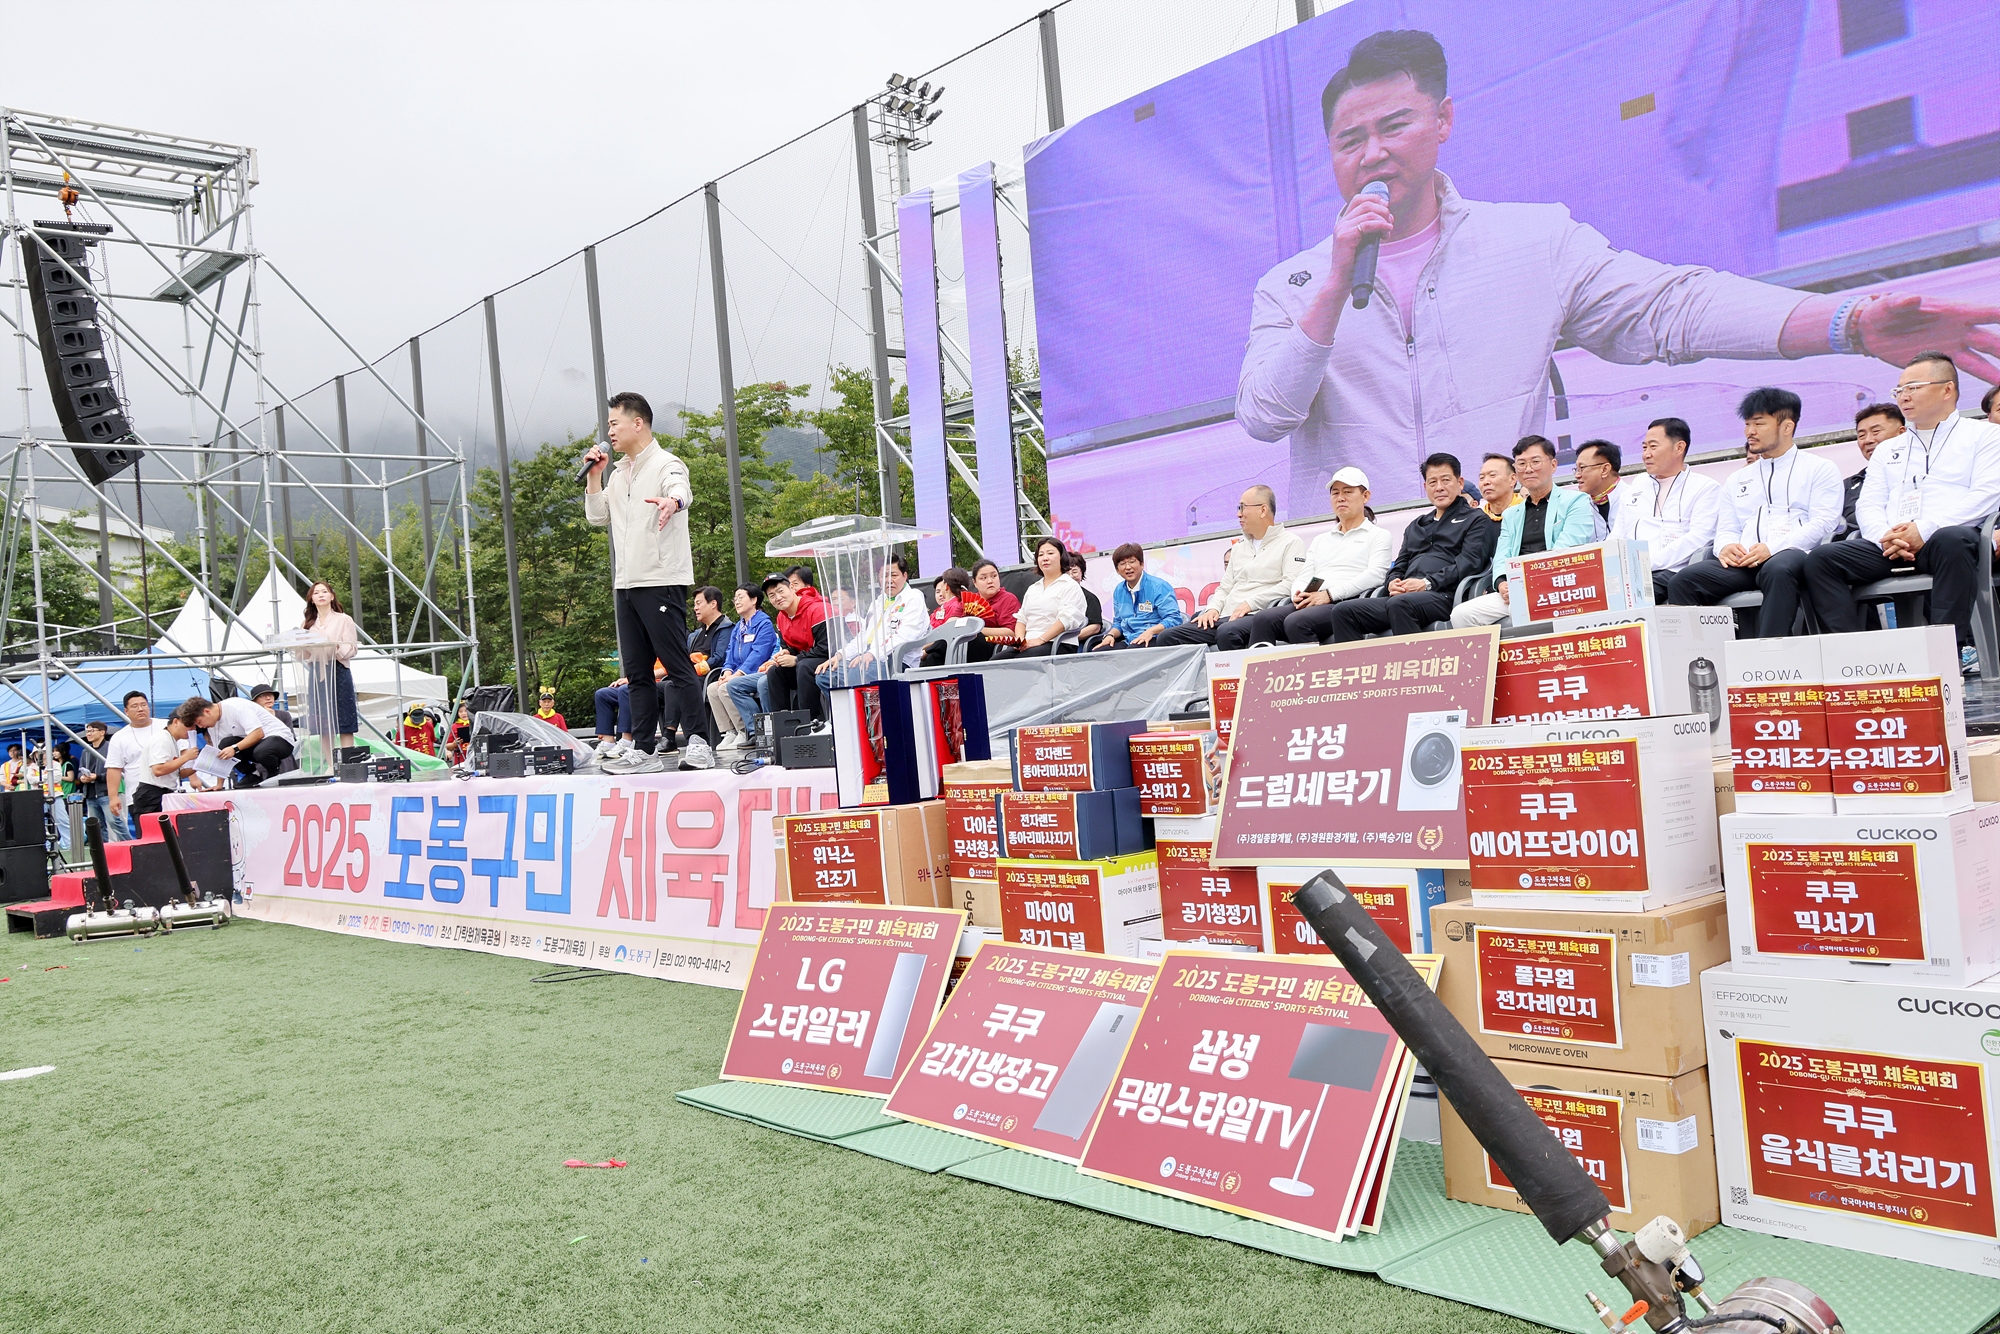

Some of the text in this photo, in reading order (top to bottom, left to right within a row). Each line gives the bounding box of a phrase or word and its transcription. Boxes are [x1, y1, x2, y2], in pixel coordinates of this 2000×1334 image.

[1571, 553, 1595, 563] 체육대회
[1551, 573, 1577, 588] 테팔
[1537, 586, 1597, 607] 스팀다리미
[1700, 615, 1728, 625] CUCKOO
[1498, 635, 1627, 663] 2025 도봉구민 체육대회
[1263, 655, 1460, 694] 2025 도봉구민 체육대회
[1742, 669, 1802, 682] OROWA
[1841, 662, 1907, 678] OROWA
[1270, 684, 1445, 708] DOBONG-GU CITIZENS' SPORTS FESTIVAL
[1538, 676, 1589, 703] 쿠쿠
[1745, 691, 1791, 703] 도봉구민
[1844, 687, 1894, 700] 도봉구민
[1674, 721, 1706, 735] CUCKOO
[1754, 719, 1802, 741] 오와
[1855, 717, 1908, 740] 오와
[1286, 723, 1347, 762] 삼성
[1035, 746, 1073, 761] 전자랜드
[1468, 750, 1625, 771] 2025 도봉구민 체육대회
[1023, 763, 1088, 778] 종아리마사지기
[1143, 763, 1183, 779] 닌텐도
[962, 788, 987, 799] 도봉구민
[1140, 783, 1191, 799] 스위치 2
[1235, 768, 1391, 808] 드럼세탁기
[1519, 792, 1577, 821] 쿠쿠
[794, 819, 871, 833] 2025 도봉구민 체육대회
[963, 816, 998, 834] 다이슨
[1020, 813, 1058, 827] 전자랜드
[1978, 815, 1999, 829] CUCKOO
[1008, 831, 1074, 845] 종아리마사지기
[1237, 829, 1437, 845] (주)경일종합개발, (주)경원환경개발, (주)백승기업 증
[1469, 828, 1639, 857] 에어프라이어
[1856, 828, 1937, 841] CUCKOO
[282, 803, 372, 894] 2025
[384, 793, 574, 915] 도봉구민
[813, 845, 856, 864] 위닉스
[1166, 847, 1188, 858] 2025
[1762, 850, 1898, 863] 2025 도봉구민 체육대회
[815, 869, 857, 888] 건조기
[1005, 872, 1090, 885] 2025 도봉구민 체육대회
[1201, 876, 1232, 897] 쿠쿠
[1805, 880, 1859, 904] 쿠쿠
[1024, 901, 1075, 924] 마이어
[1182, 902, 1258, 926] 공기청정기
[778, 915, 940, 940] 2025 도봉구민 체육대회
[1794, 910, 1876, 936] 믹서기
[380, 917, 391, 933] (토)
[392, 920, 410, 934] 09:00
[417, 923, 434, 938] 17:00
[440, 927, 452, 940] 장소
[453, 925, 501, 947] 다락원체육공원
[543, 936, 587, 957] 도봉구체육회
[598, 945, 610, 958] 후원
[628, 949, 651, 963] 도봉구
[659, 952, 673, 967] 문의
[674, 955, 686, 968] 02)
[687, 956, 731, 973] 990-4141~2
[827, 935, 914, 949] CITIZENS' SPORTS FESTIVAL
[1019, 929, 1086, 951] 전기그릴
[1489, 936, 1599, 955] 2025 도봉구민 체육대회
[1147, 950, 1162, 958] Rinnai
[796, 956, 847, 994] LG
[986, 956, 1025, 975] 2025
[1025, 959, 1090, 985] 도봉구민
[1089, 967, 1155, 994] 체육대회
[1173, 967, 1218, 990] 2025
[1220, 971, 1297, 998] 도봉구민
[1514, 964, 1575, 990] 풀무원
[1036, 981, 1126, 1002] CITIZENS' SPORTS FESTIVAL
[1716, 991, 1788, 1005] EFF201DCNW
[1235, 997, 1349, 1019] CITIZENS' SPORTS FESTIVAL
[1496, 990, 1598, 1019] 전자레인지
[749, 1002, 871, 1048] 스타일러
[982, 1002, 1046, 1043] 쿠쿠
[1746, 1012, 1762, 1020] 처리기
[1189, 1029, 1260, 1079] 삼성
[1509, 1042, 1588, 1059] MICROWAVE OVEN
[794, 1062, 826, 1072] 도봉구체육회
[919, 1041, 1059, 1100] 김치냉장고
[1759, 1052, 1957, 1089] 2025 도봉구민 체육대회
[1831, 1075, 1926, 1092] CITIZENS' FESTIVAL
[967, 1108, 1002, 1122] 도봉구체육회
[1112, 1077, 1311, 1150] 무빙스타일TV
[1523, 1096, 1607, 1116] 도봉구민 체육대회
[1823, 1101, 1897, 1139] 쿠쿠
[1177, 1162, 1221, 1181] 도봉구체육회
[1760, 1133, 1977, 1196] 음식물처리기
[1189, 1174, 1217, 1187] Sports Council
[1840, 1195, 1876, 1210] 한국마사회
[1877, 1200, 1907, 1216] 도봉지사
[1733, 1213, 1807, 1231] CUCKOOELECTRONICS
